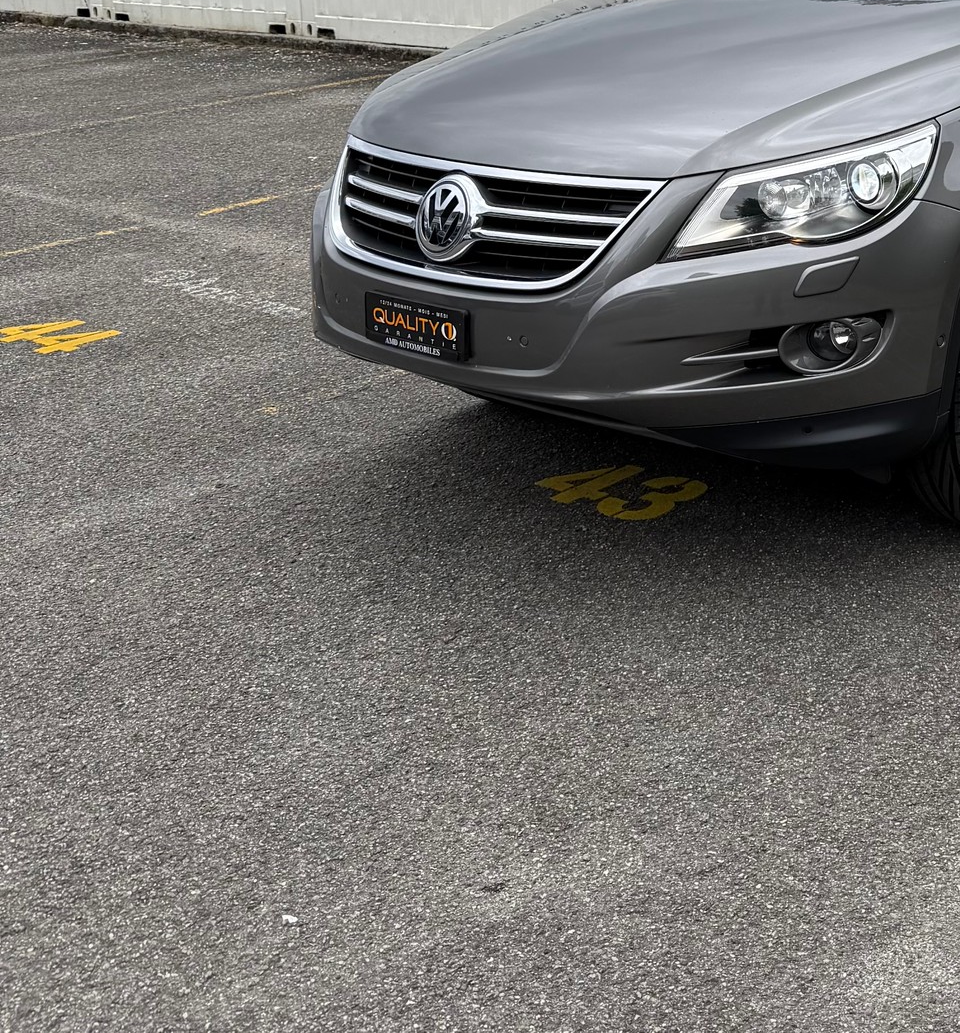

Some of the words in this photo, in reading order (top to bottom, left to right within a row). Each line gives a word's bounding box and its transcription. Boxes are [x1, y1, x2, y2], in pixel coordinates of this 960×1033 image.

[373, 307, 440, 336] QUALITY
[399, 340, 440, 356] AUTOMOBILES
[534, 464, 709, 521] 43
